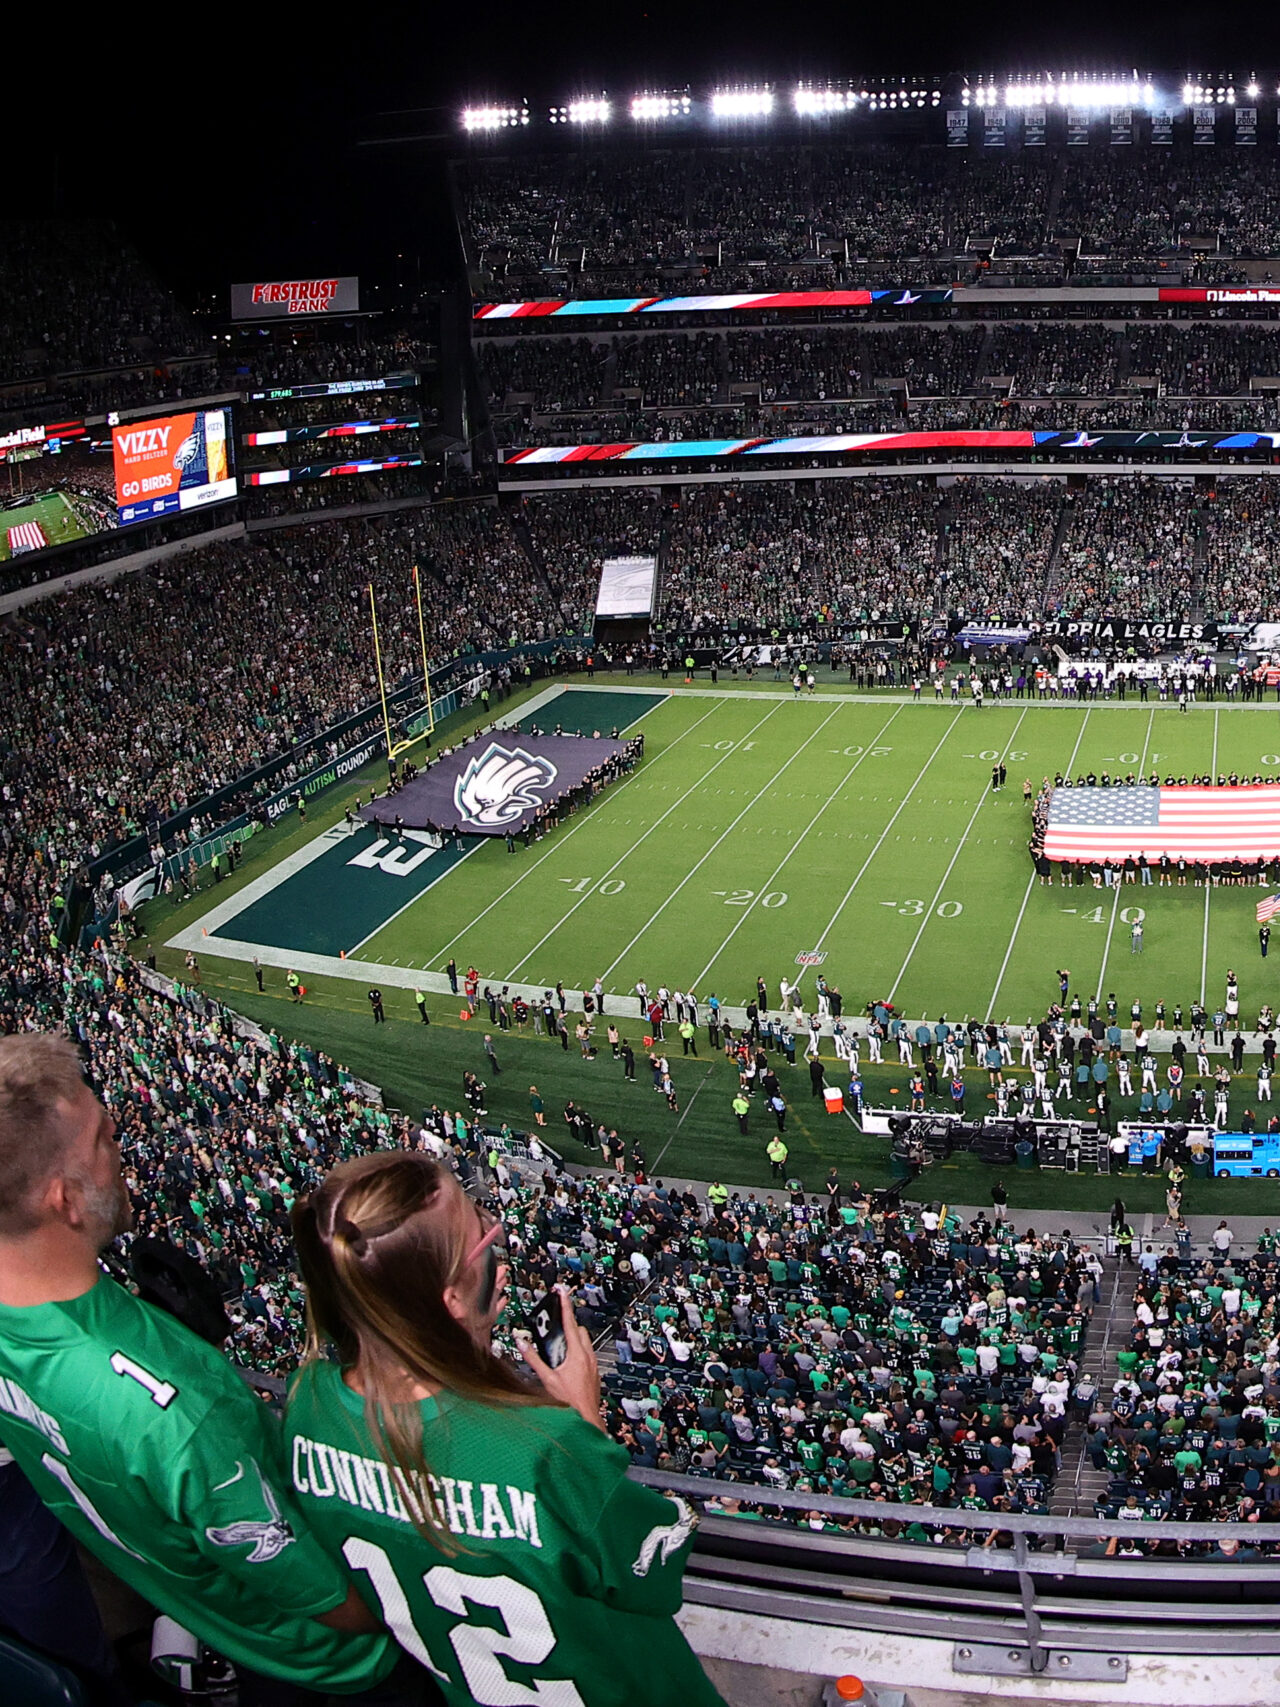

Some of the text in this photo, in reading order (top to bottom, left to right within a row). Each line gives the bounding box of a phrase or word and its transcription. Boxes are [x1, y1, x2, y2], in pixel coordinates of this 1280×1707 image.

[1238, 118, 1255, 126] 2002
[288, 299, 330, 314] BANK
[1218, 291, 1257, 302] Lincoln
[21, 425, 46, 444] Field
[117, 426, 172, 455] VIZZY
[122, 481, 139, 497] GO
[142, 472, 172, 492] BIRDS
[197, 488, 218, 500] verizon
[304, 769, 336, 796] AUTISM
[567, 876, 627, 896] 10
[724, 888, 789, 909] 20
[898, 899, 964, 918] 30
[1081, 905, 1146, 925] 40
[799, 956, 820, 964] NFL
[110, 1351, 178, 1409] 1
[341, 1536, 590, 1707] 12
